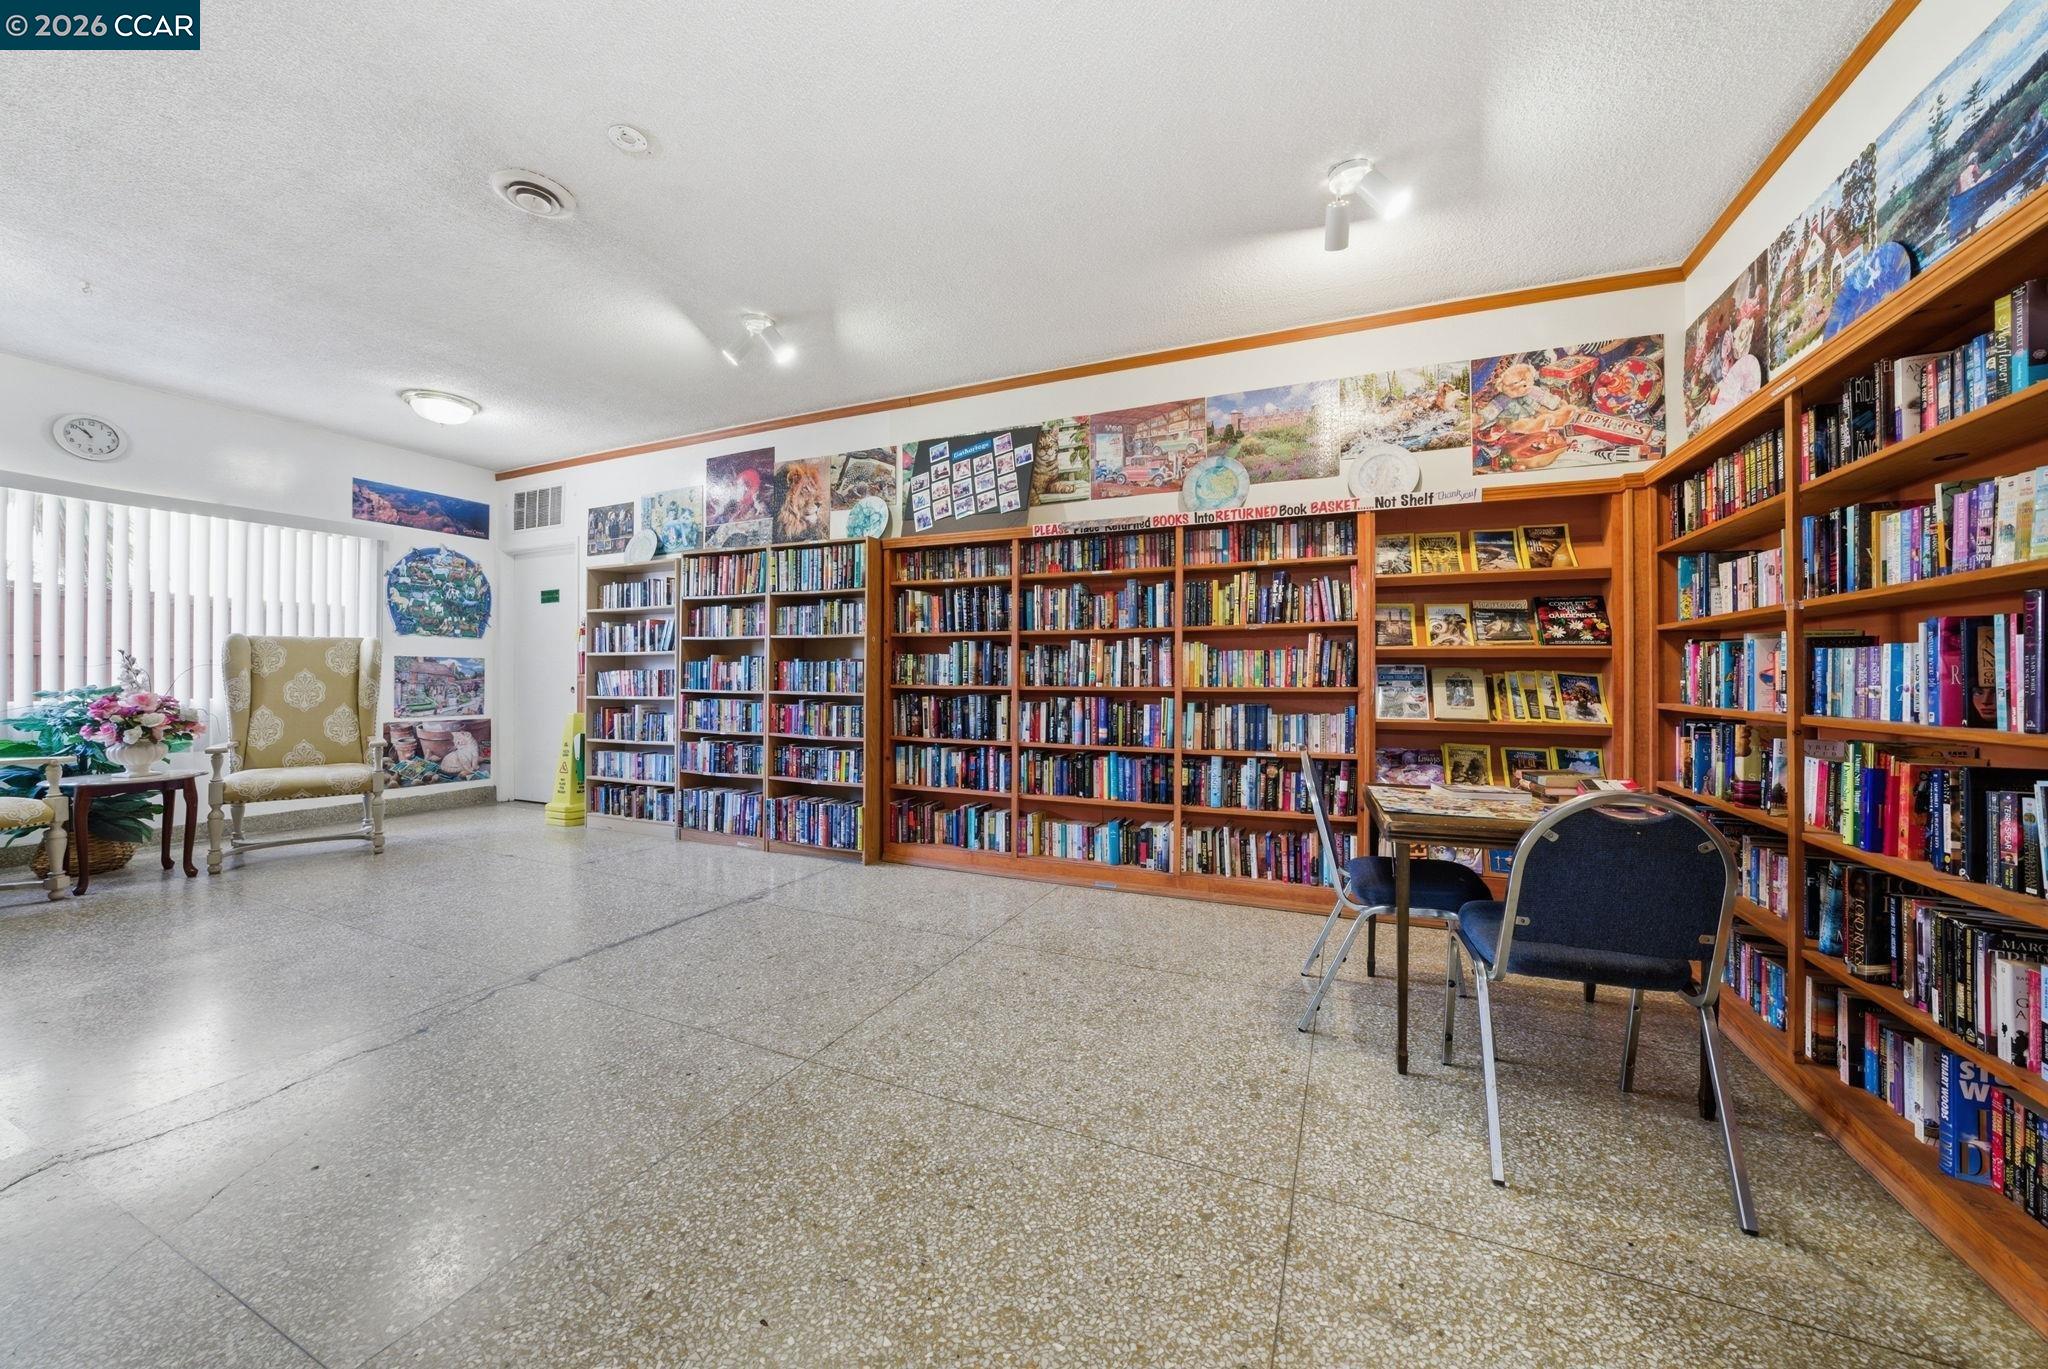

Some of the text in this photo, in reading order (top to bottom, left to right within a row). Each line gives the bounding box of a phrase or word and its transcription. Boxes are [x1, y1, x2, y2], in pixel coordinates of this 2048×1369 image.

[1995, 315, 2012, 382] Mayflower
[1152, 512, 1189, 527] BOOKS
[1194, 511, 1215, 524] Into
[1215, 504, 1278, 522] RETURNED
[1279, 503, 1308, 517] Book
[1374, 496, 1397, 509] Not
[1400, 492, 1435, 507] Shelf
[2003, 805, 2012, 850] TERRY SPEAR
[1853, 898, 1865, 966] LORD RINGS
[1941, 1054, 1949, 1121] STUART WOODS
